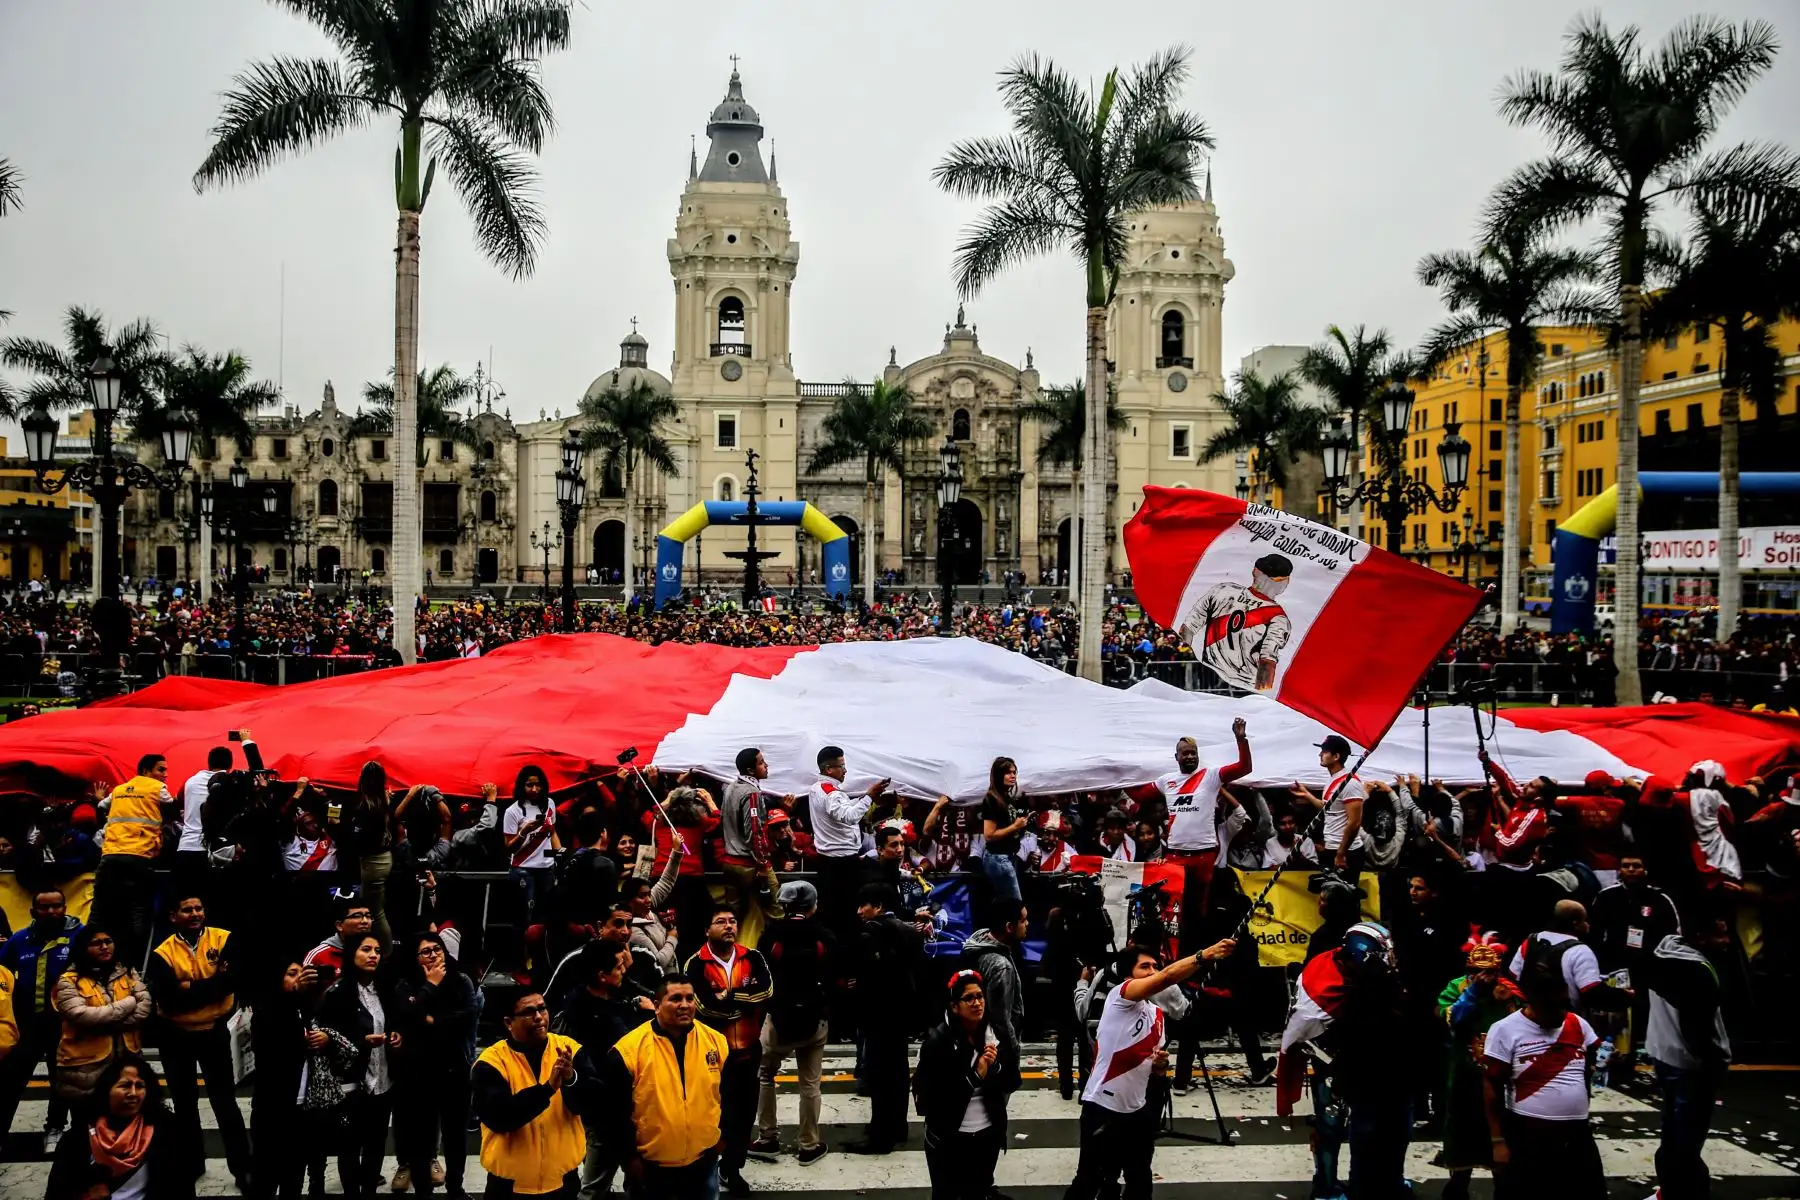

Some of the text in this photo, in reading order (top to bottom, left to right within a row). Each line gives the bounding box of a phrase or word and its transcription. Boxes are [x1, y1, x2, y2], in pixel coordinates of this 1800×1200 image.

[1709, 536, 1752, 558] PÚ!
[1289, 929, 1308, 944] de
[1132, 1019, 1144, 1037] 9
